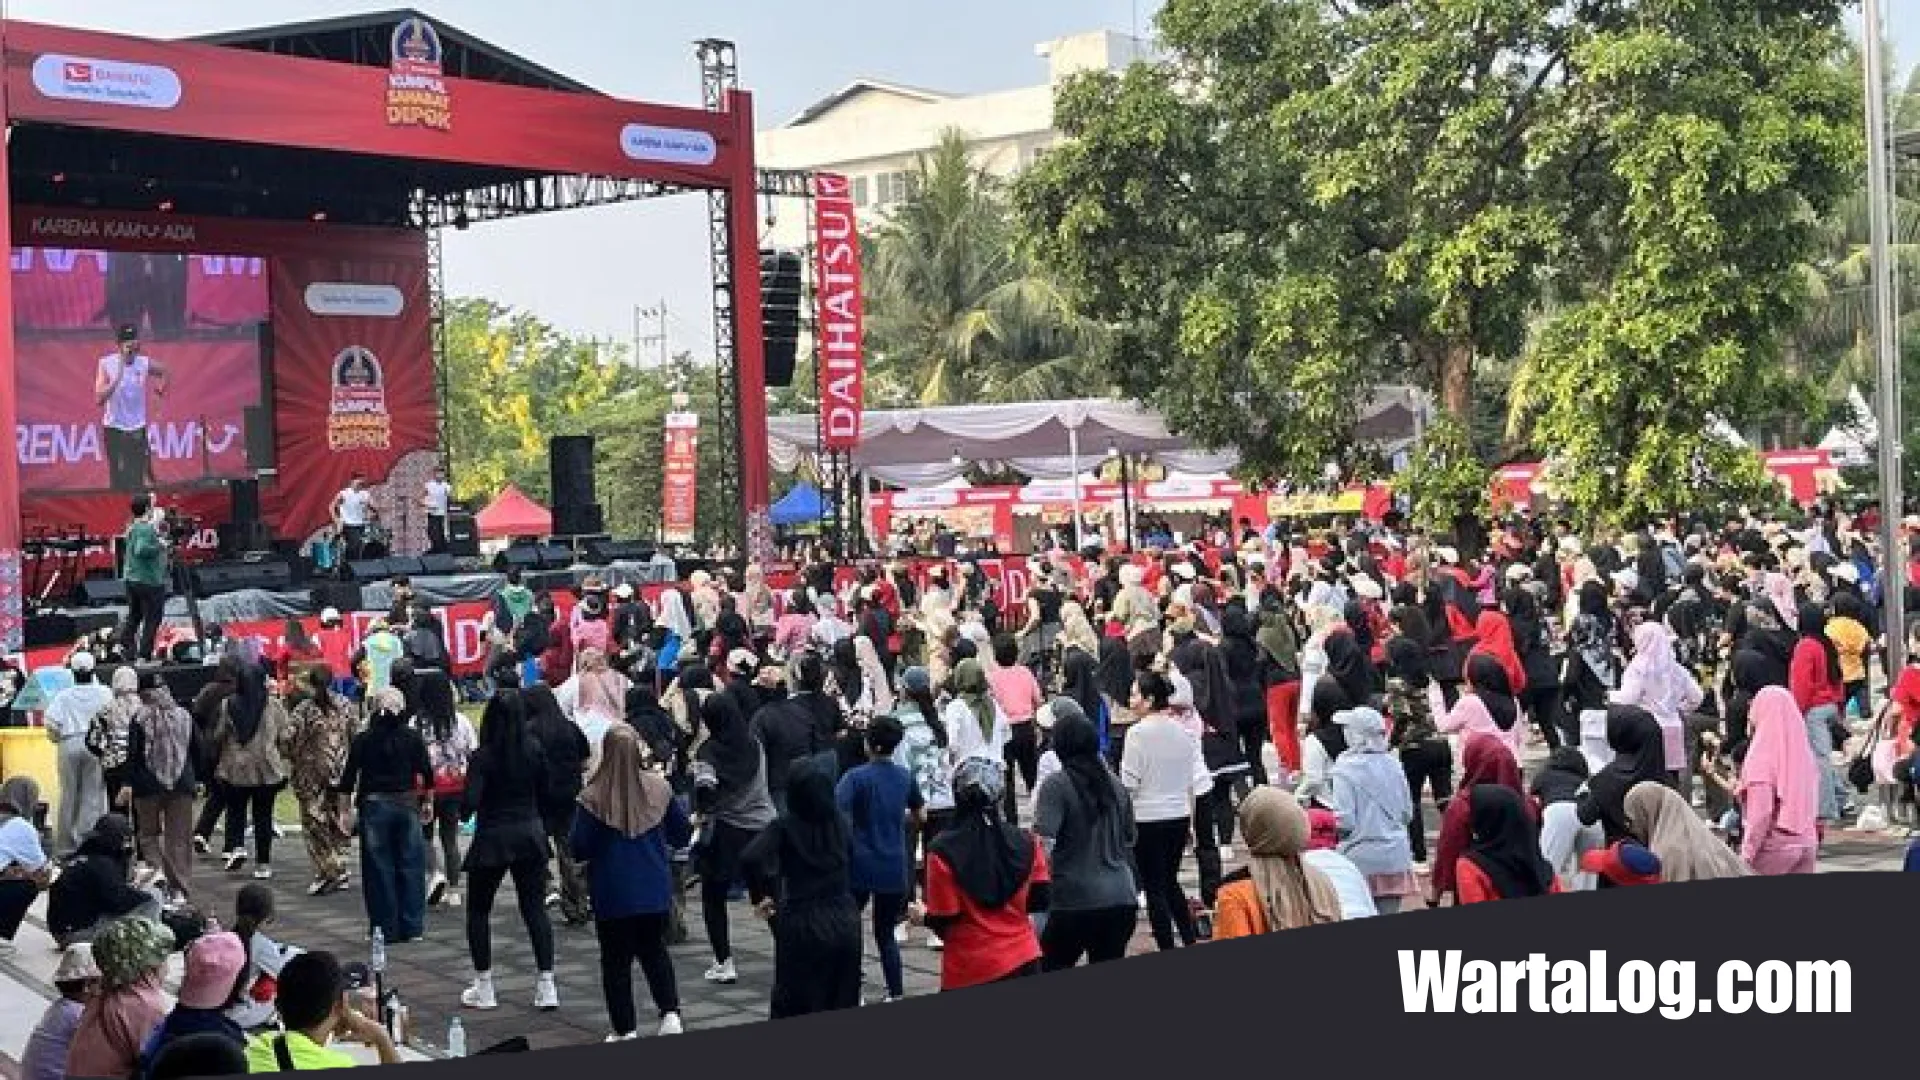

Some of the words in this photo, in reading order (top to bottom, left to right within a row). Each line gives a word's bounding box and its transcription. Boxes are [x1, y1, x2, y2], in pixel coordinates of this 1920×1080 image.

[386, 106, 451, 130] DEPOK
[32, 216, 99, 236] KARENA
[164, 223, 196, 241] ADA
[823, 211, 857, 437] DAIHATSU
